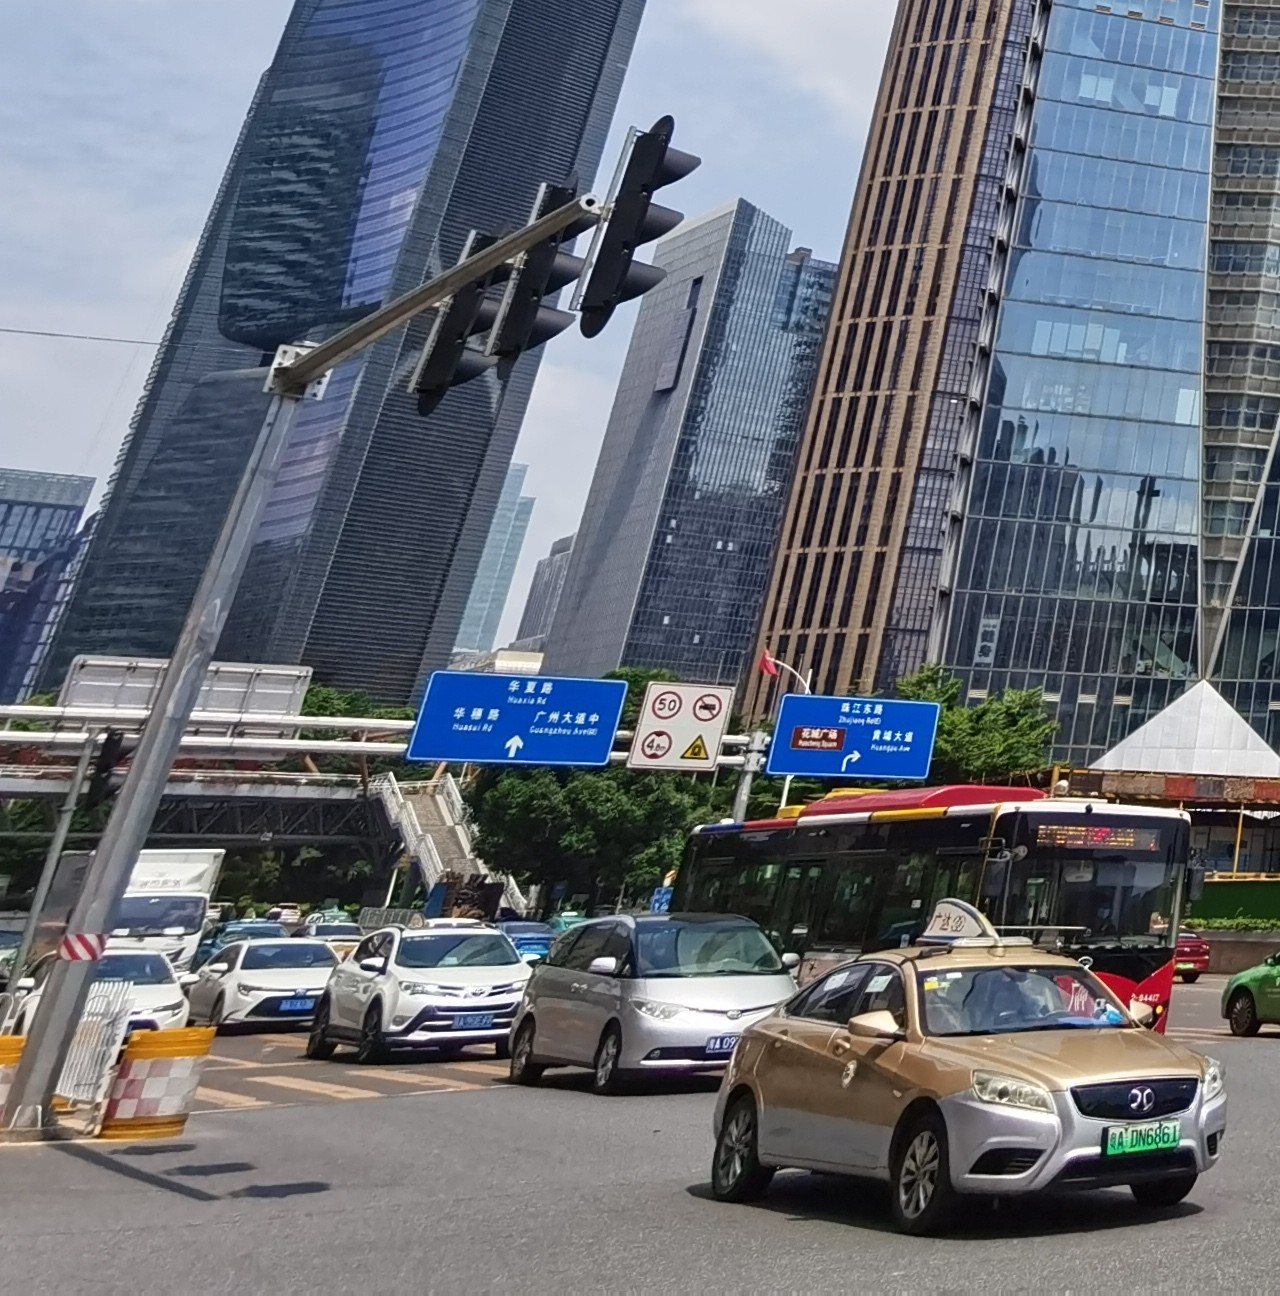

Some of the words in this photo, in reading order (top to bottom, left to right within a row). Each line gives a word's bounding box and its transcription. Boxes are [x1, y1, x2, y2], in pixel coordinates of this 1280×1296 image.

[508, 679, 554, 695] 华夏路
[507, 695, 535, 705] Huaxia
[537, 696, 547, 705] Rd
[657, 697, 676, 712] 50
[453, 706, 500, 721] 华穗路
[840, 702, 884, 716] 珠江东路
[533, 710, 600, 725] 广州大道中
[452, 722, 480, 732] Huasui
[482, 723, 493, 733] Rd
[529, 725, 572, 736] Guangzhou
[801, 727, 839, 741] 花城广场
[871, 729, 914, 743] 黄埔大道
